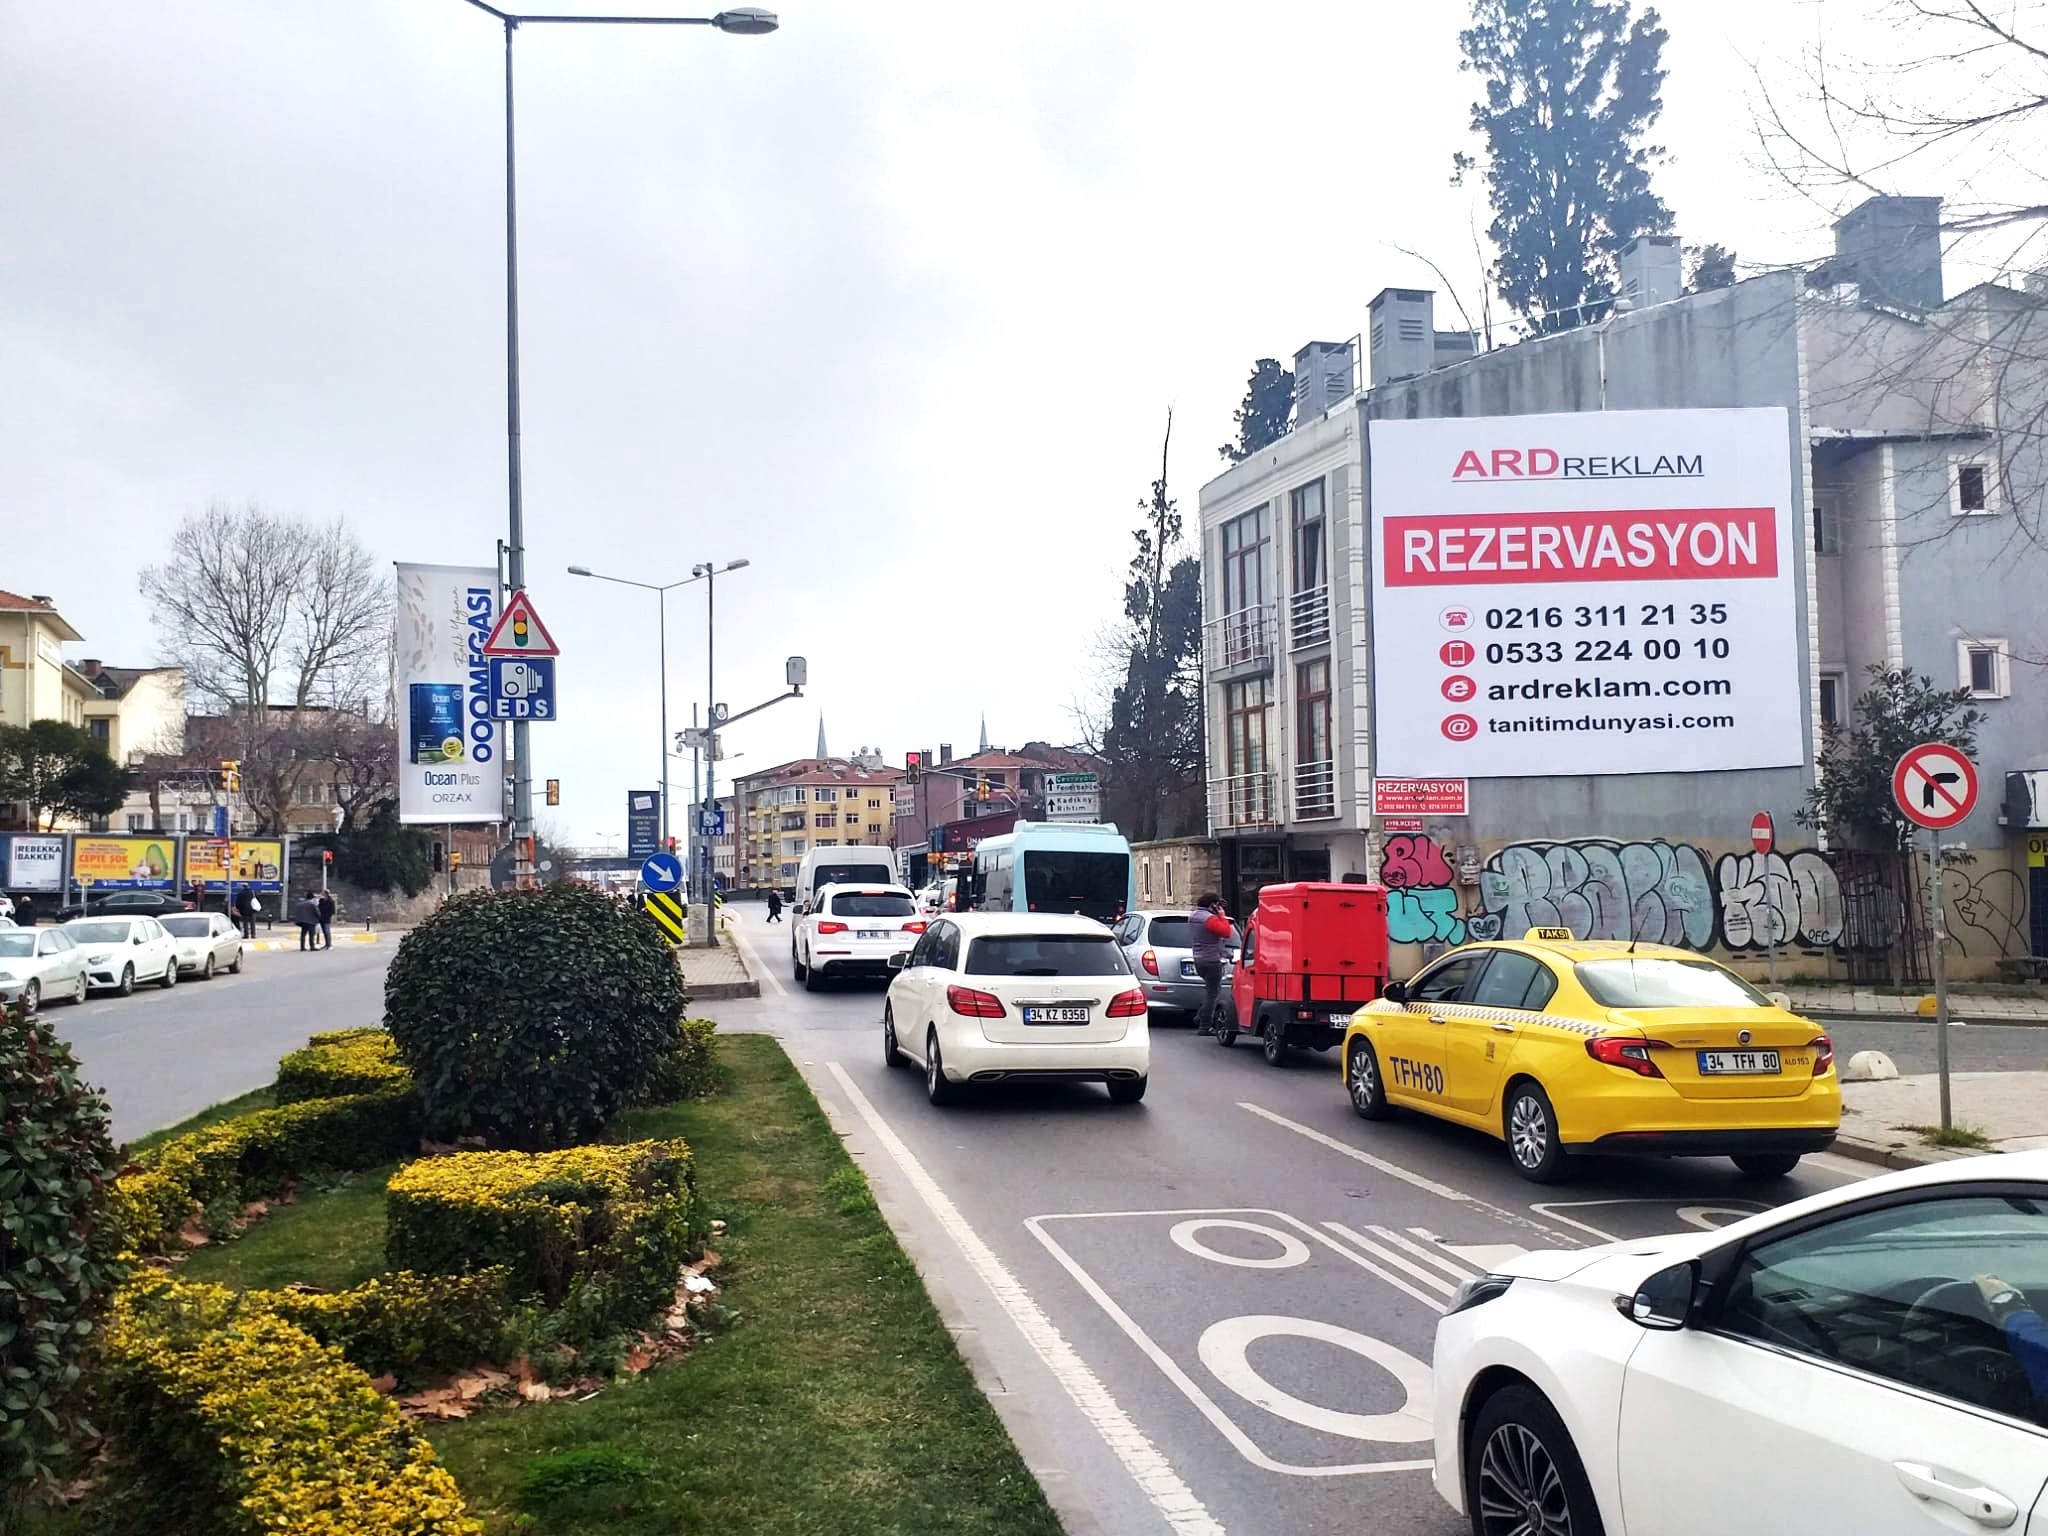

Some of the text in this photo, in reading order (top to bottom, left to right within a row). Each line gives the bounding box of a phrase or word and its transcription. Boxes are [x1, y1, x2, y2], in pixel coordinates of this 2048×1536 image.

[1403, 521, 1758, 573] REZERVASYON
[1485, 603, 1728, 630] 0216 311 21 35
[1486, 638, 1730, 664] 0533 224 00 10
[1488, 677, 1732, 701] ardreklam.com
[496, 698, 549, 718] EDS
[1488, 713, 1734, 734] tanitimdunyasi.com
[424, 771, 481, 786] Ocean Plus
[1377, 782, 1463, 793] REZERVASYON
[432, 793, 472, 803] ORZAX
[701, 827, 722, 835] EDS
[17, 845, 61, 853] REBEKKA
[1030, 1009, 1086, 1020] 34 KZ 8358
[1708, 1053, 1778, 1069] 34 TFH 80
[1389, 1056, 1444, 1095] TFH80
